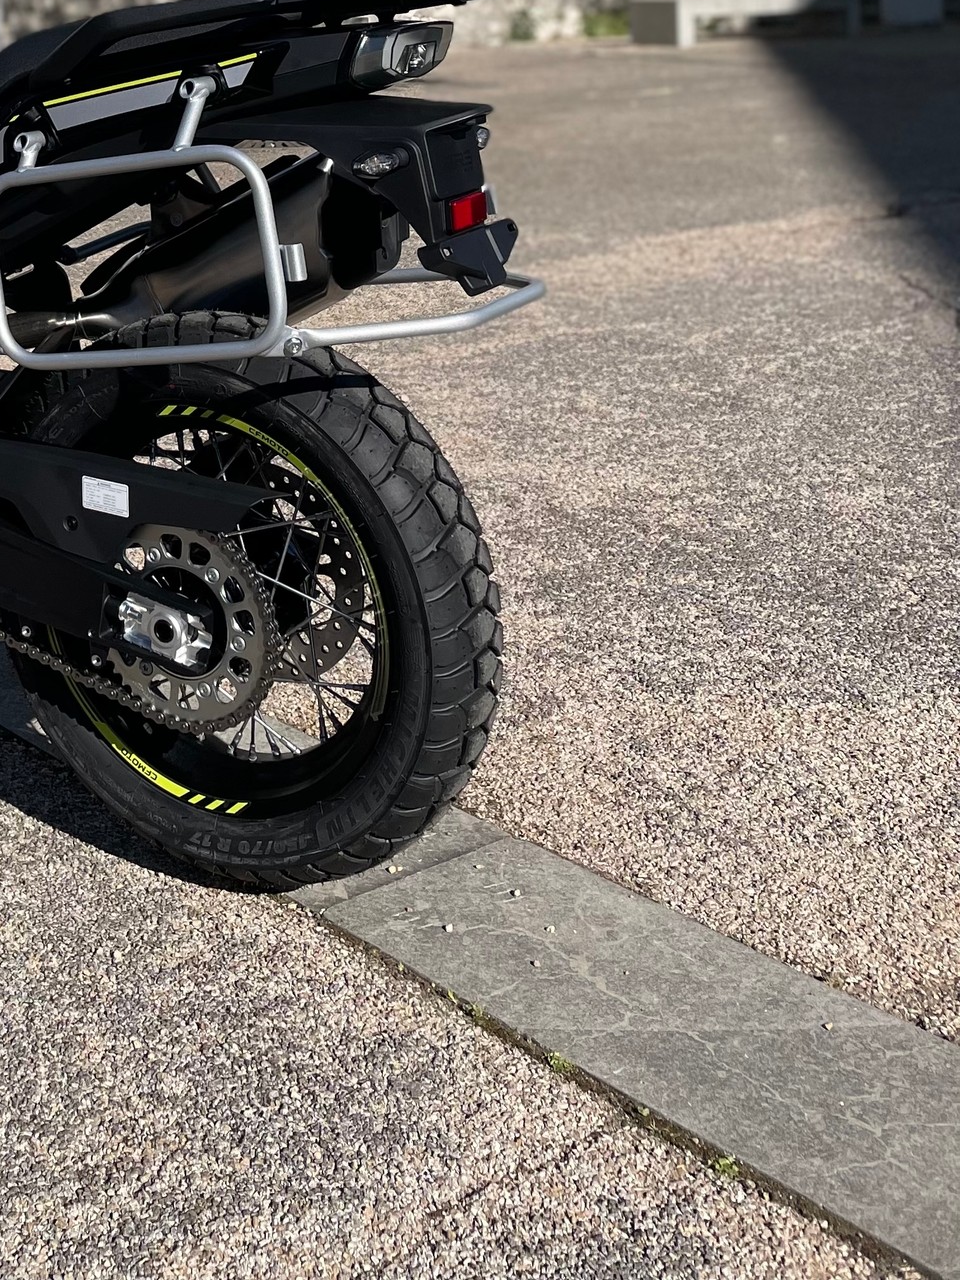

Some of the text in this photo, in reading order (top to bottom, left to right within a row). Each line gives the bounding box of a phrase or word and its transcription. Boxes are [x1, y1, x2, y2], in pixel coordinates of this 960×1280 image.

[248, 427, 289, 457] CFMOTO
[120, 747, 158, 781] CFMOTO
[324, 692, 425, 842] MICHELIN
[189, 831, 212, 847] 17
[216, 836, 231, 853] R
